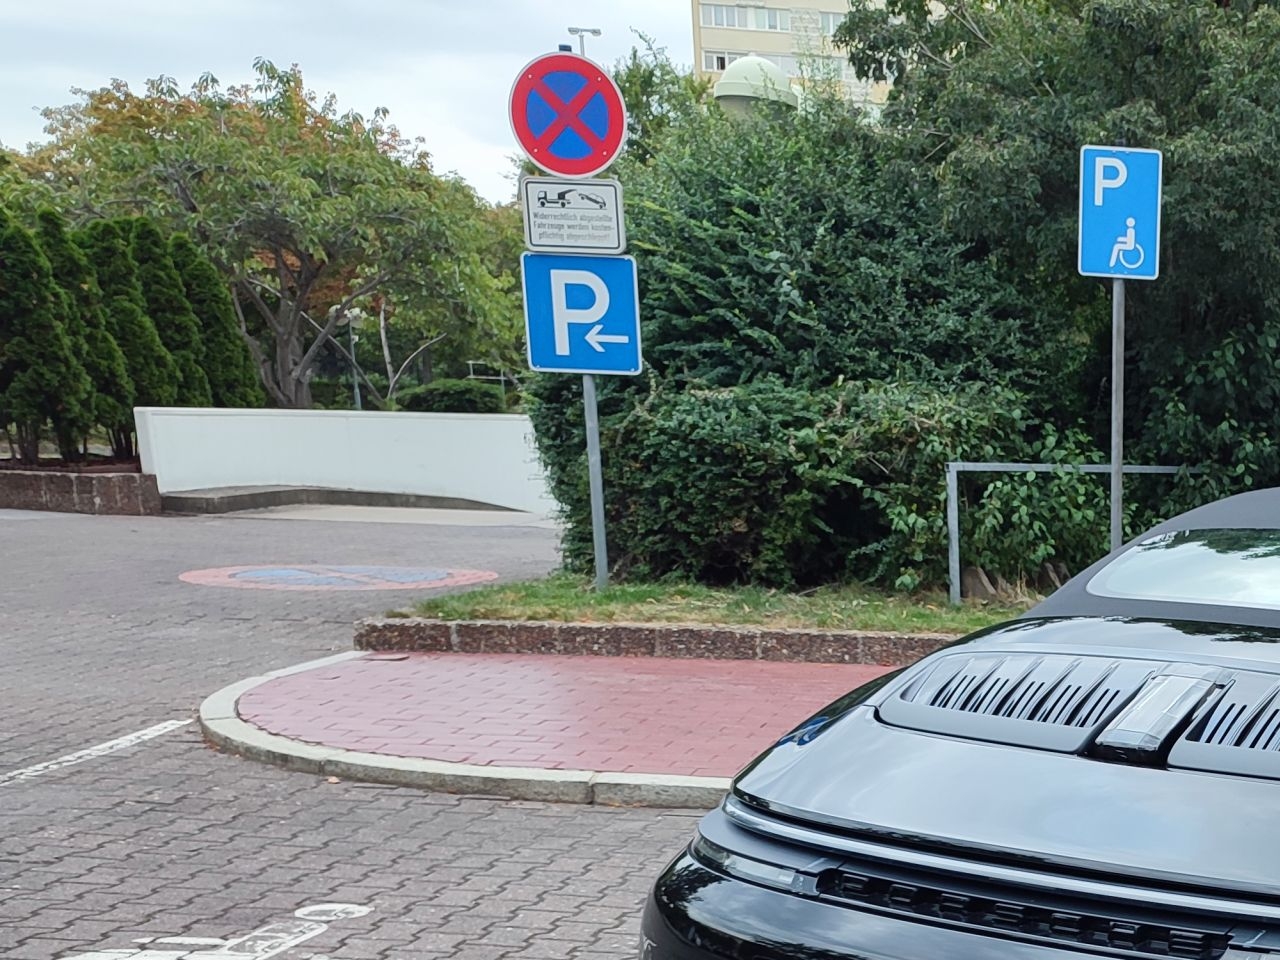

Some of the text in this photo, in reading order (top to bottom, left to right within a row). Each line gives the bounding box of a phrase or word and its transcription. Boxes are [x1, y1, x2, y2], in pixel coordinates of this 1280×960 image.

[1094, 157, 1127, 206] P
[534, 221, 564, 231] Fahrzeuge
[550, 269, 610, 355] P
